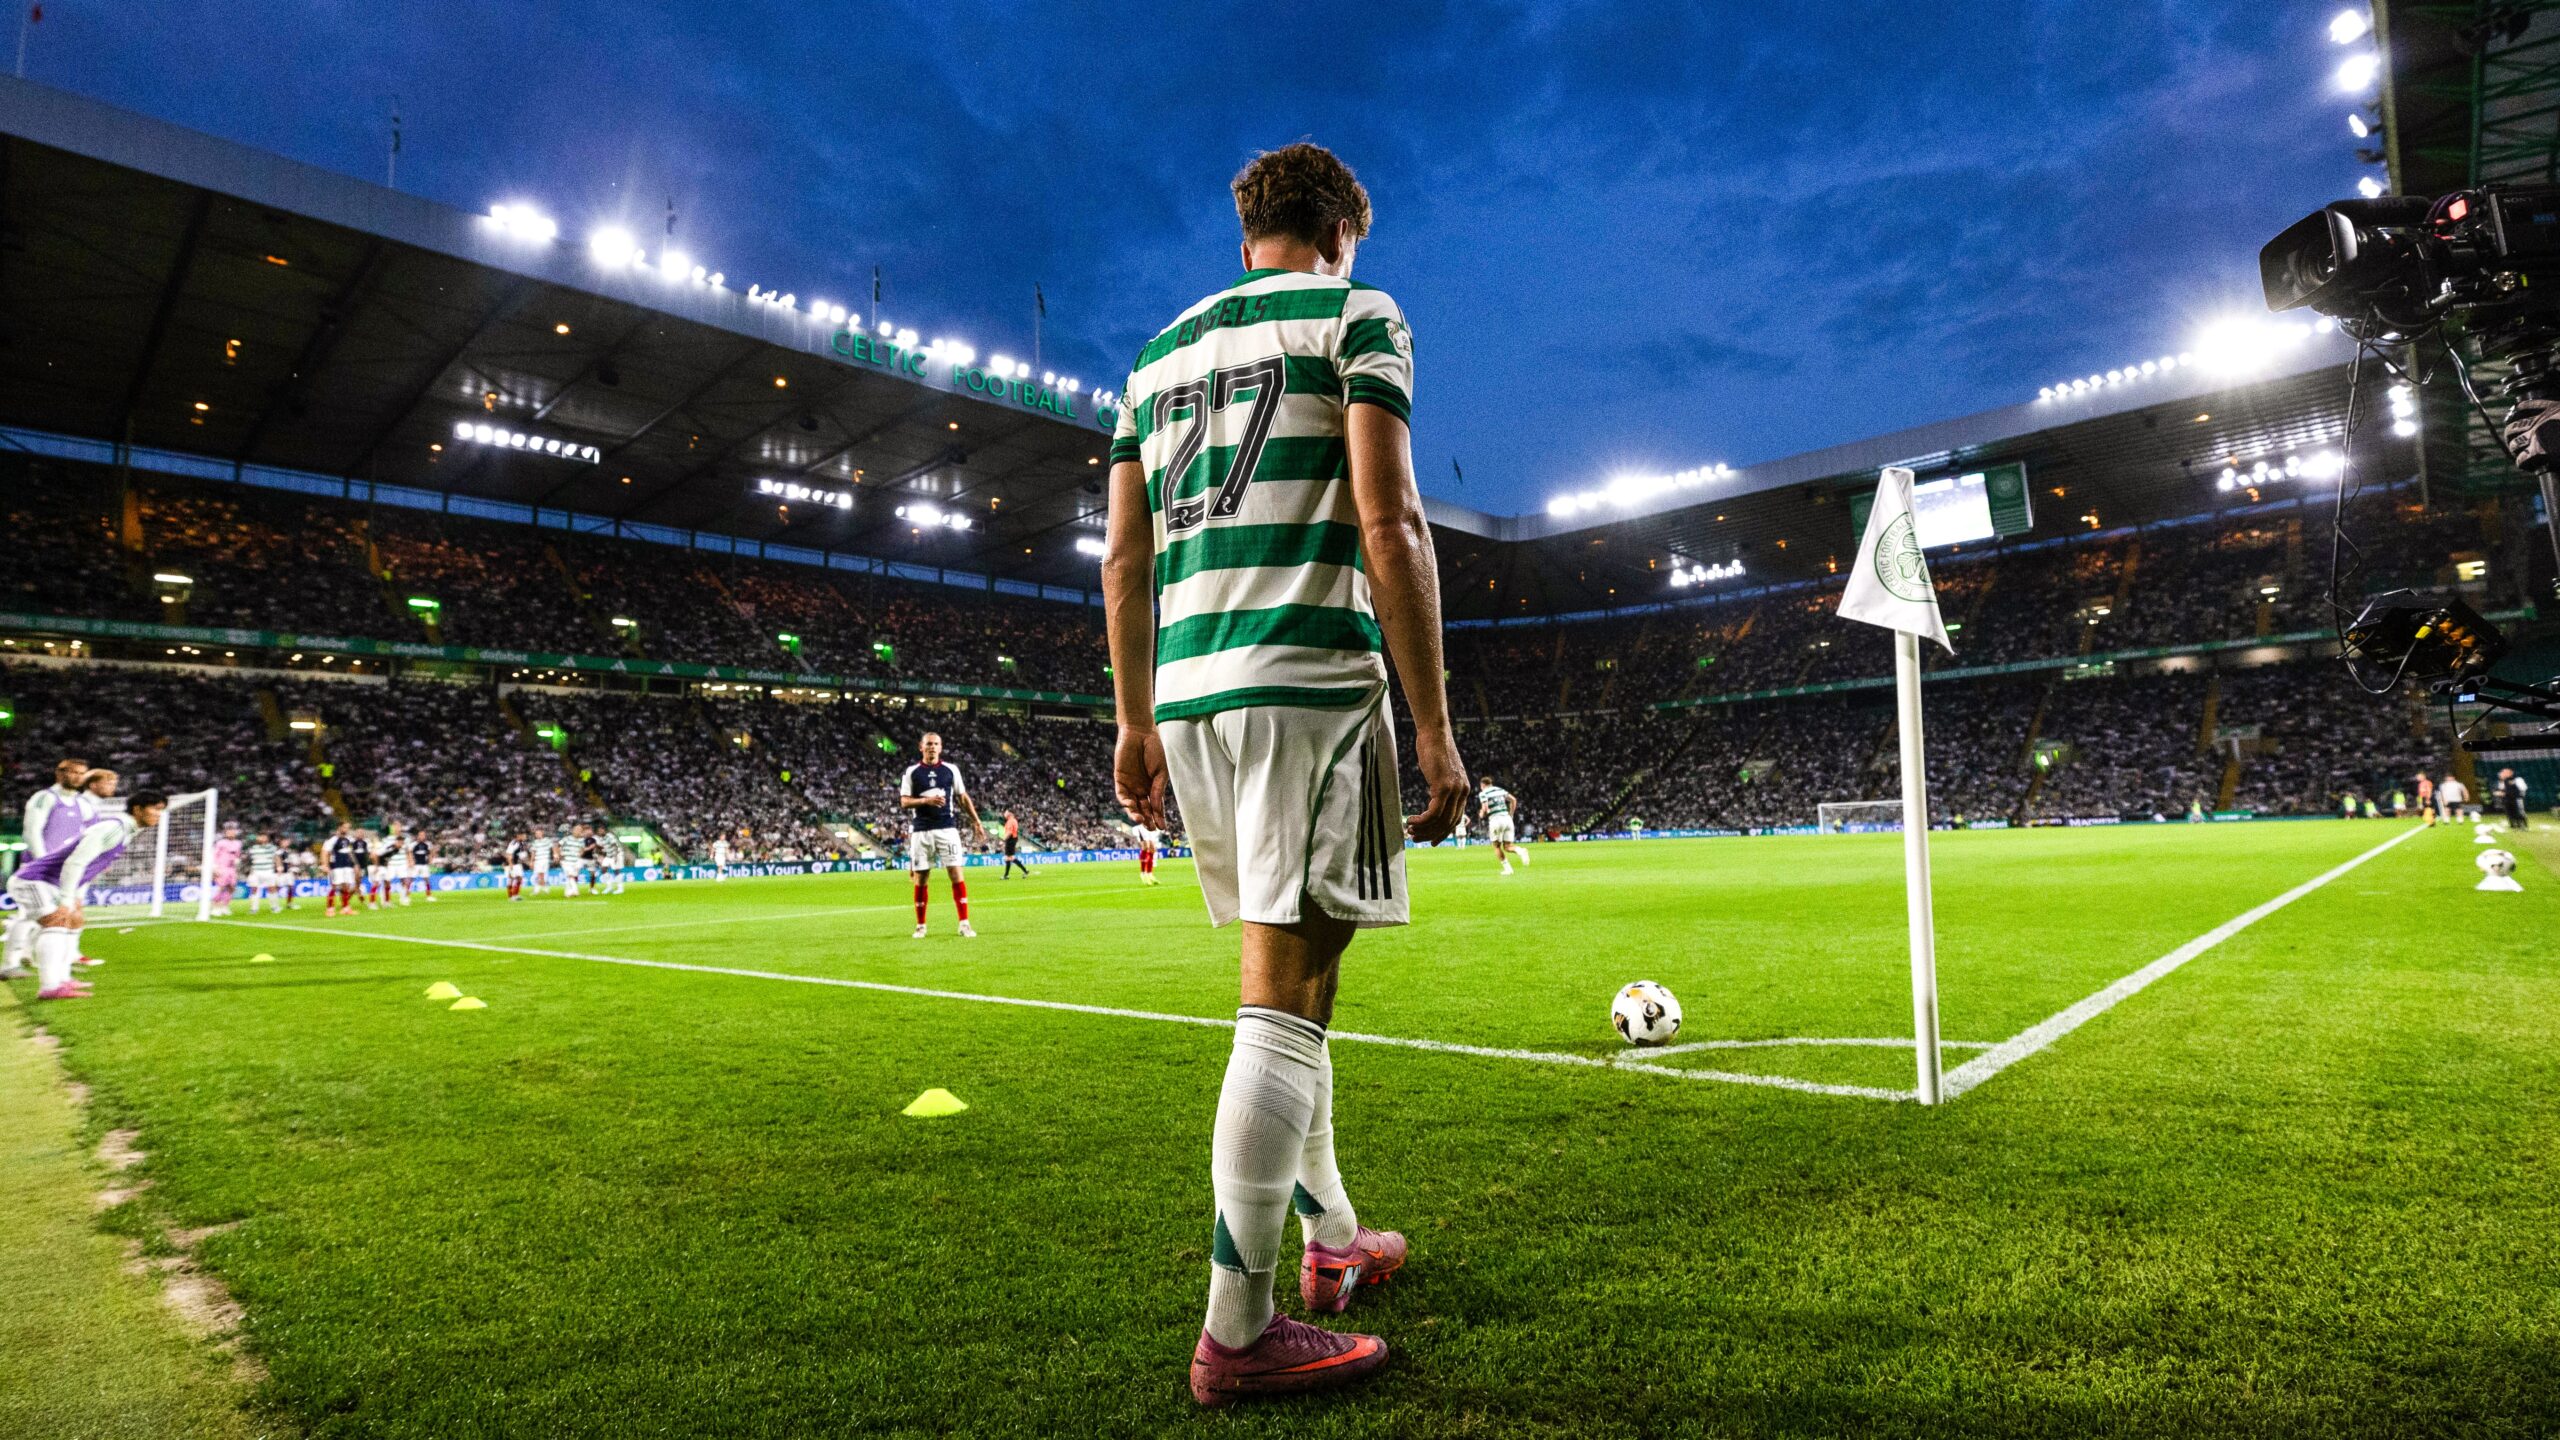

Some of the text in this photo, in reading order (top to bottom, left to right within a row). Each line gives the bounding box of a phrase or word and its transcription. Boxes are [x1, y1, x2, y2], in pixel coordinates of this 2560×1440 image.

[1176, 295, 1271, 346] ENGELS
[831, 330, 927, 378] CELTIC
[953, 364, 1077, 419] FOOTBALL
[1154, 353, 1286, 539] 27
[1880, 559, 1898, 587] CELTIC
[948, 843, 958, 855] 10
[1094, 852, 1110, 861] The
[1111, 851, 1131, 860] Club
[849, 860, 871, 871] The
[982, 856, 1000, 865] The
[1026, 855, 1034, 864] is
[1035, 854, 1062, 864] Yours
[690, 866, 716, 878] The
[752, 864, 764, 876] is
[766, 864, 804, 875] Yours
[93, 889, 152, 905] Your
